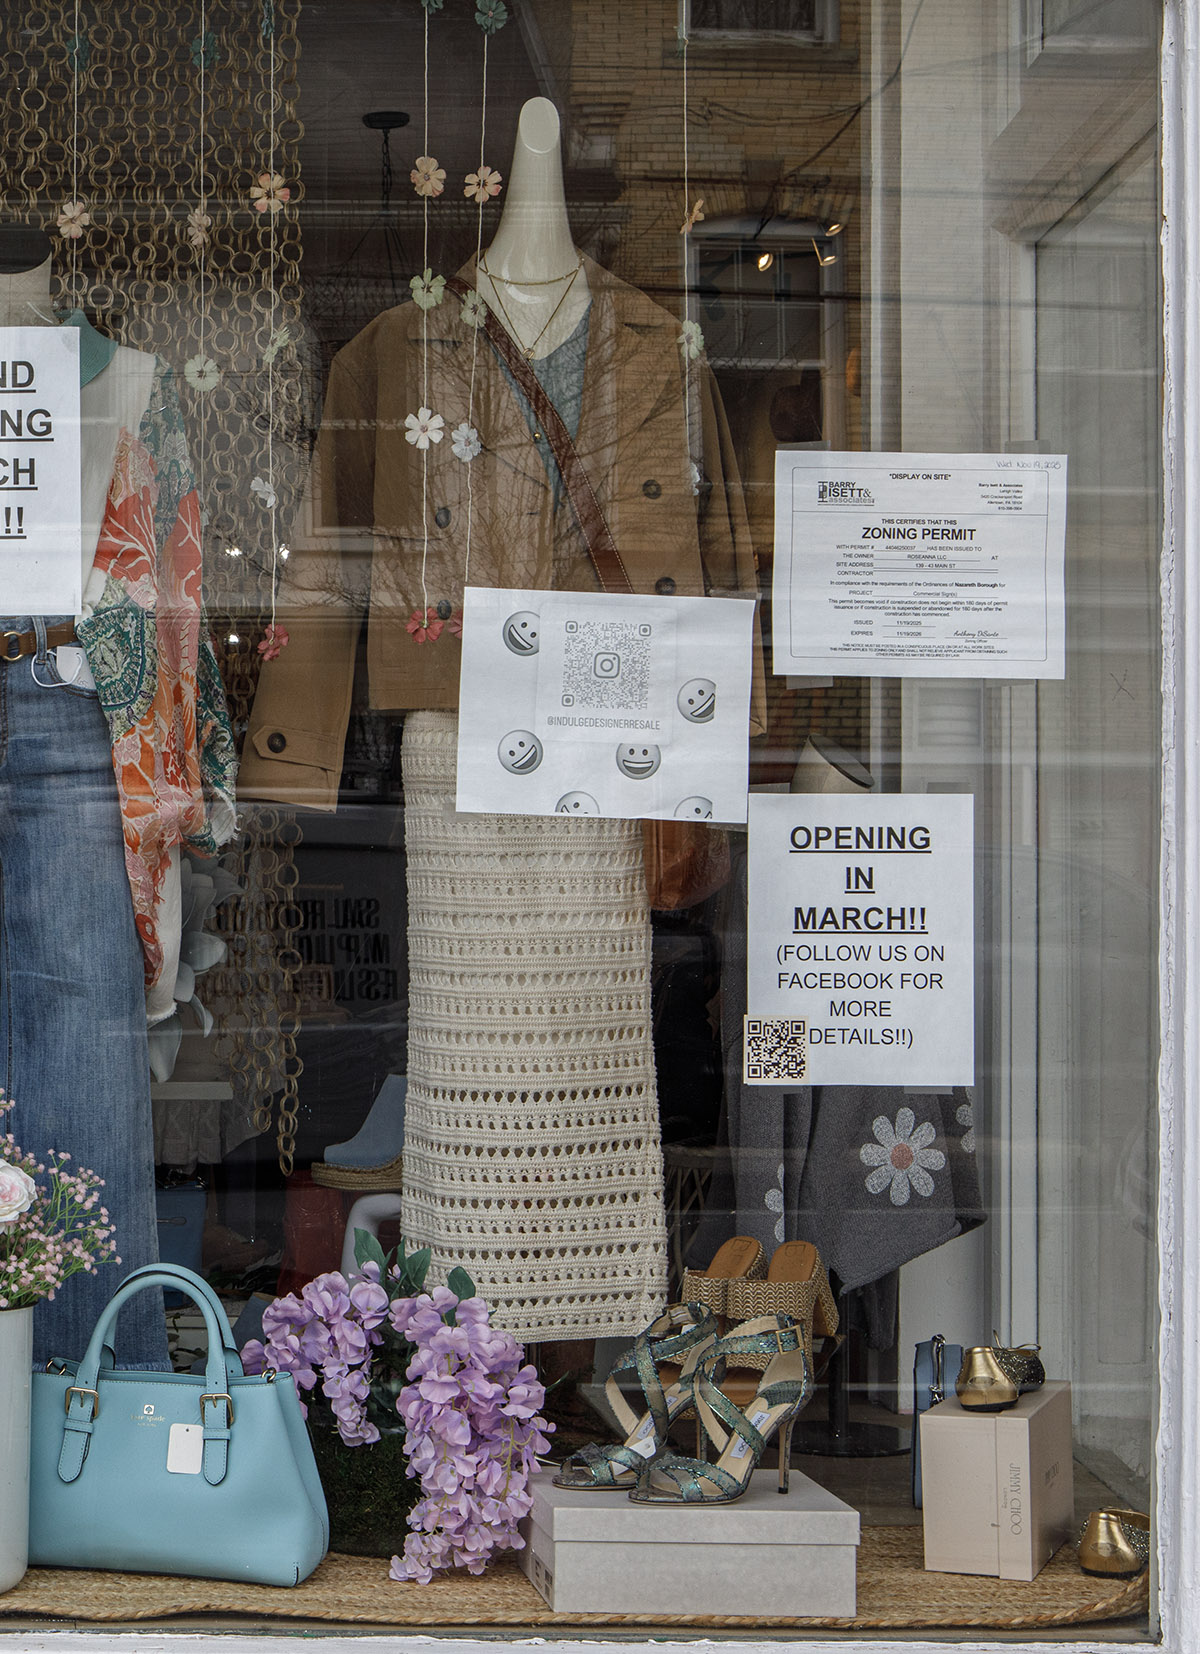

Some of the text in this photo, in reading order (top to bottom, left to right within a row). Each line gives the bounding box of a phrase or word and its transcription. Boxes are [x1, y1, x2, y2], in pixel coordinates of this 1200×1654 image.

[862, 527, 976, 540] ZONING PERMIT
[547, 716, 660, 730] @INDULGEDESIGNERRESALE
[790, 826, 931, 850] OPENING
[845, 867, 873, 889] IN
[794, 907, 926, 930] MARCH!!
[777, 945, 944, 965] (FOLLOW US ON
[778, 973, 943, 989] FACEBOOK FOR
[830, 1001, 892, 1016] MORE
[809, 1028, 914, 1049] DETAILS!!)
[1009, 1463, 1022, 1535] JIMMY CHOO
